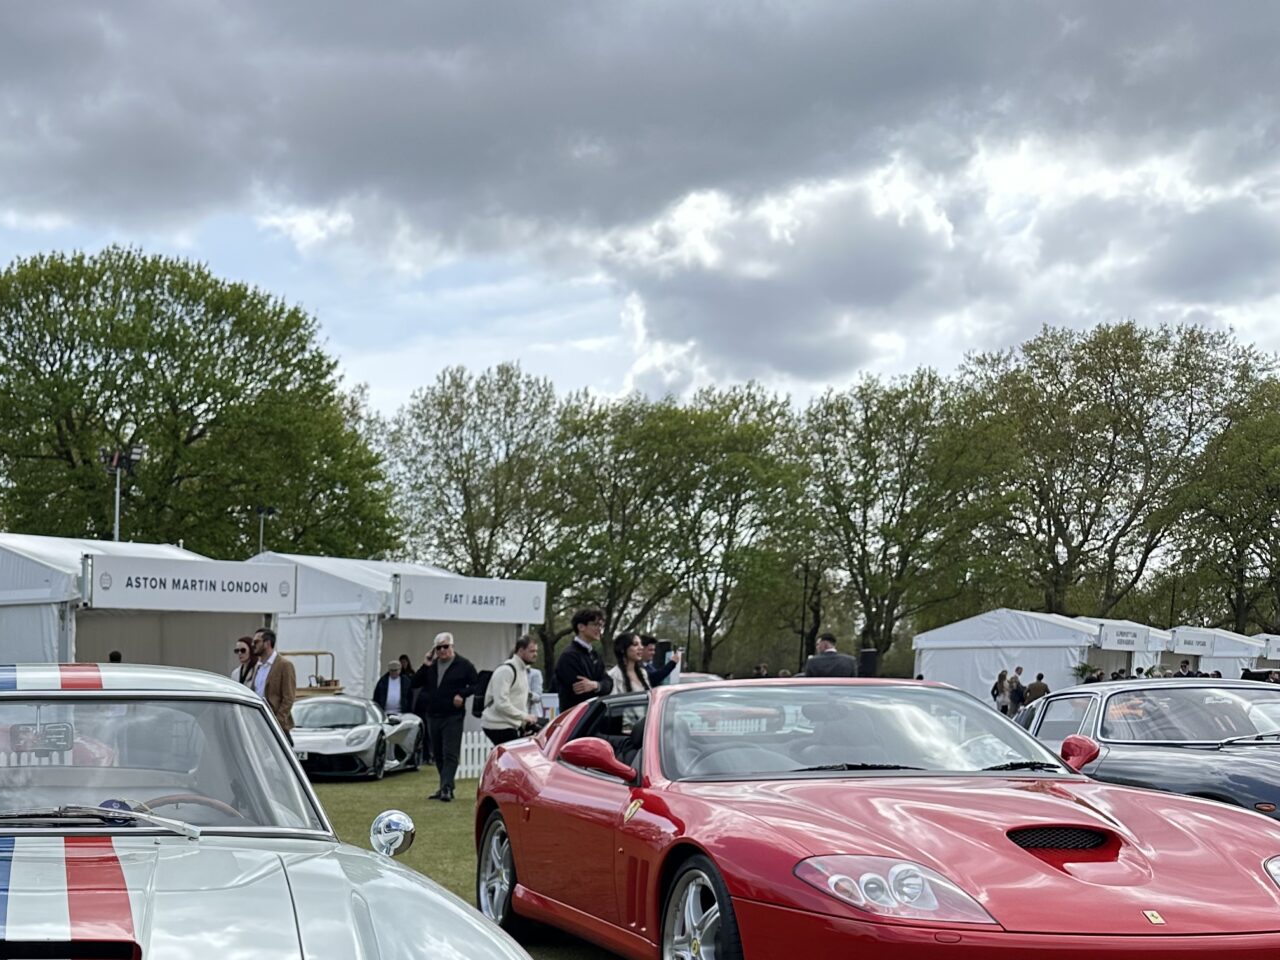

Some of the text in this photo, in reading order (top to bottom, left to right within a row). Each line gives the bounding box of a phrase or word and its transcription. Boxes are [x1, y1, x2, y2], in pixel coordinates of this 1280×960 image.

[126, 576, 268, 594] ASTON MARTIN LONDON
[444, 593, 463, 605] FIAT
[471, 595, 506, 606] ABARTH
